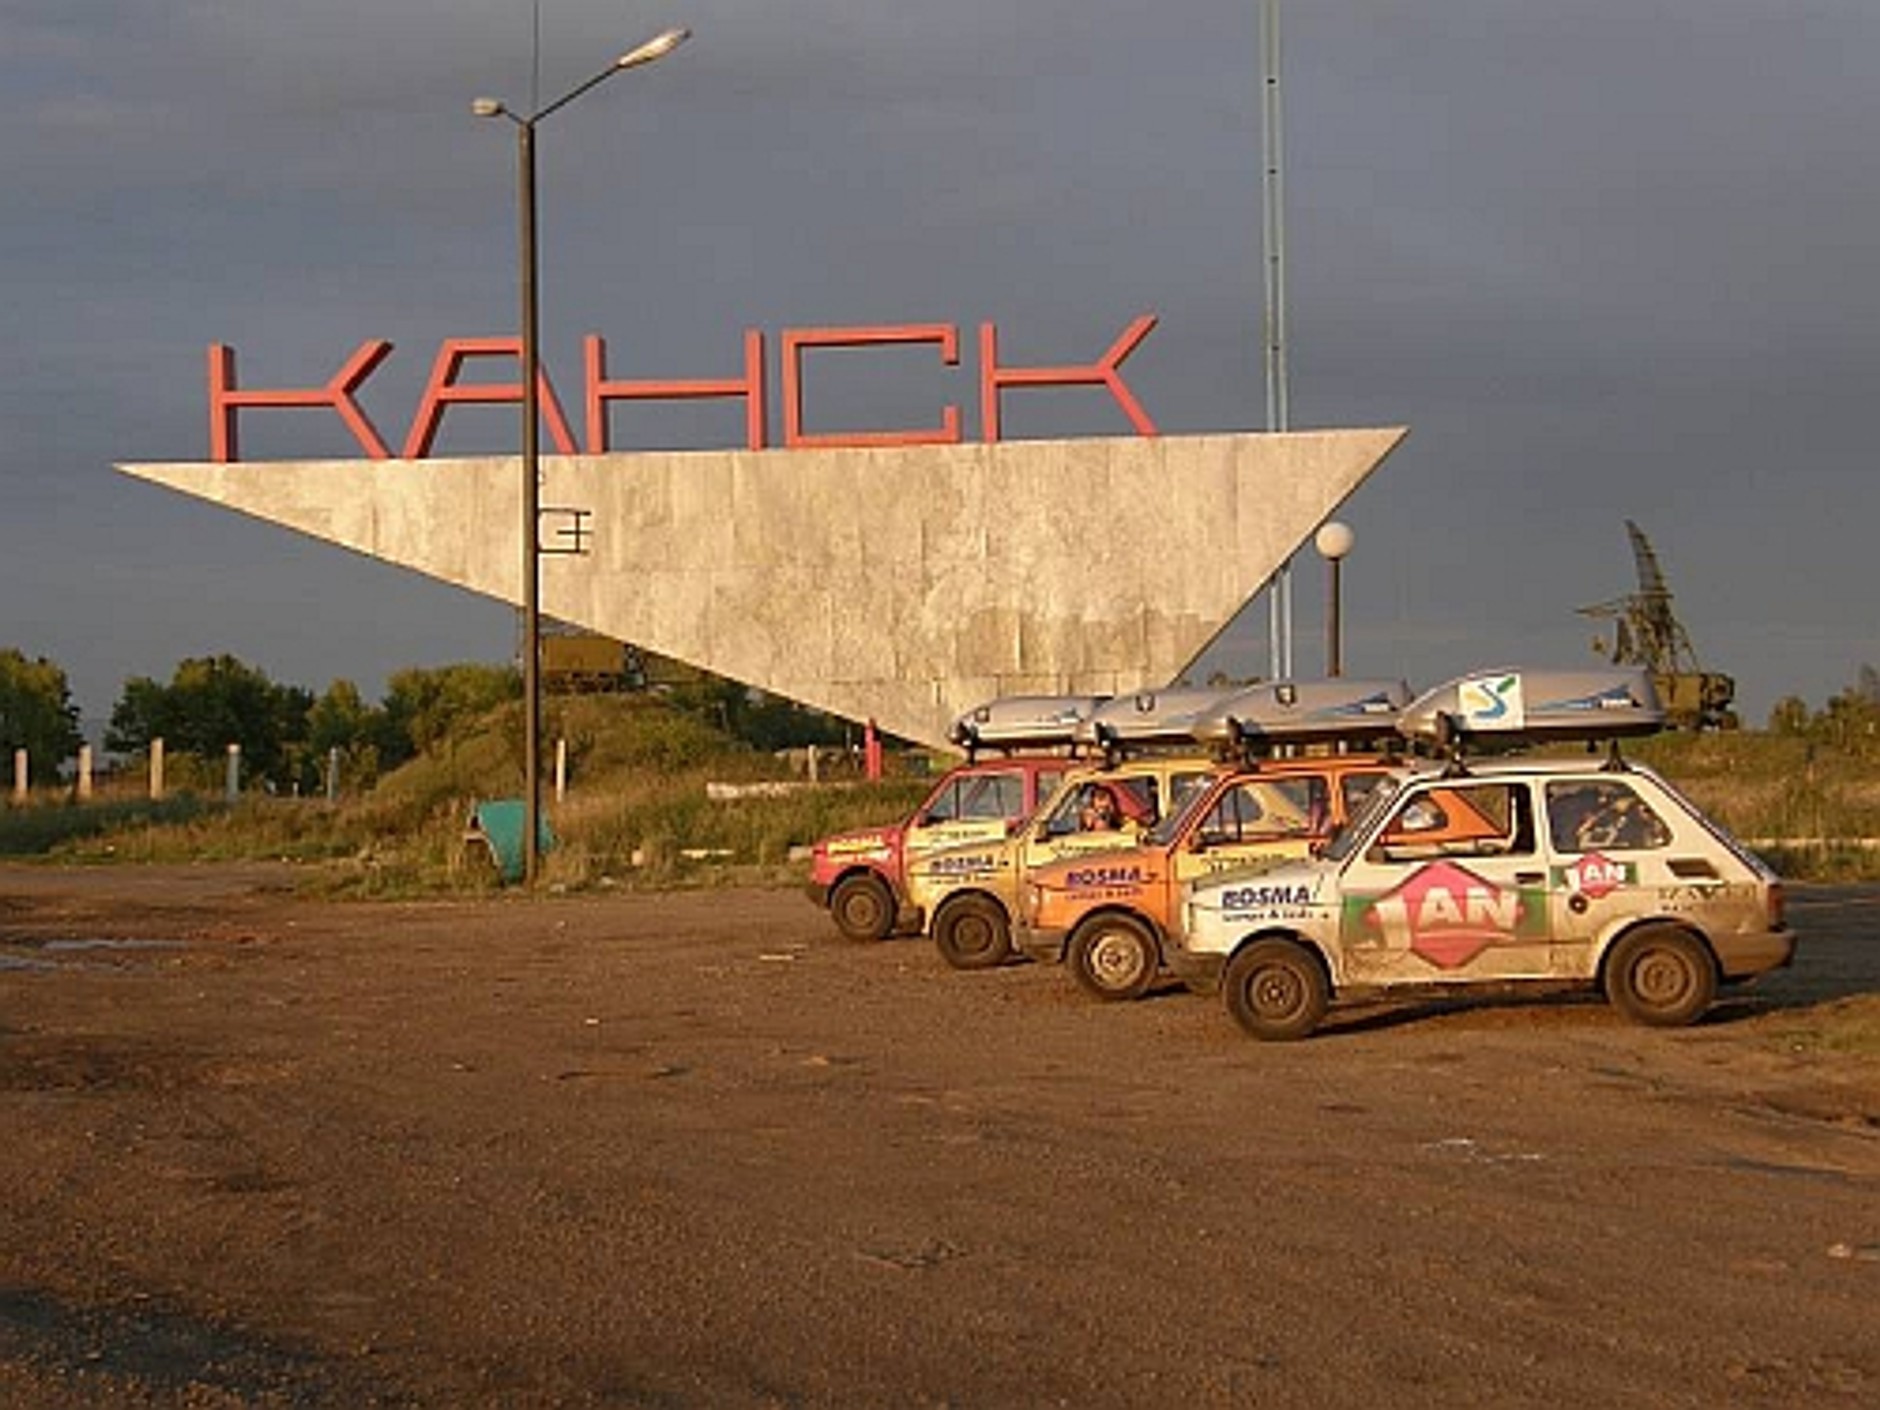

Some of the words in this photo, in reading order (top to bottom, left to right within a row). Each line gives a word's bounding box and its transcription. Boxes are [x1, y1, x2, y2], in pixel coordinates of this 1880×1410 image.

[208, 313, 1159, 461] КАНСК
[1066, 865, 1141, 888] BOSMA
[1222, 886, 1310, 909] BOSMA
